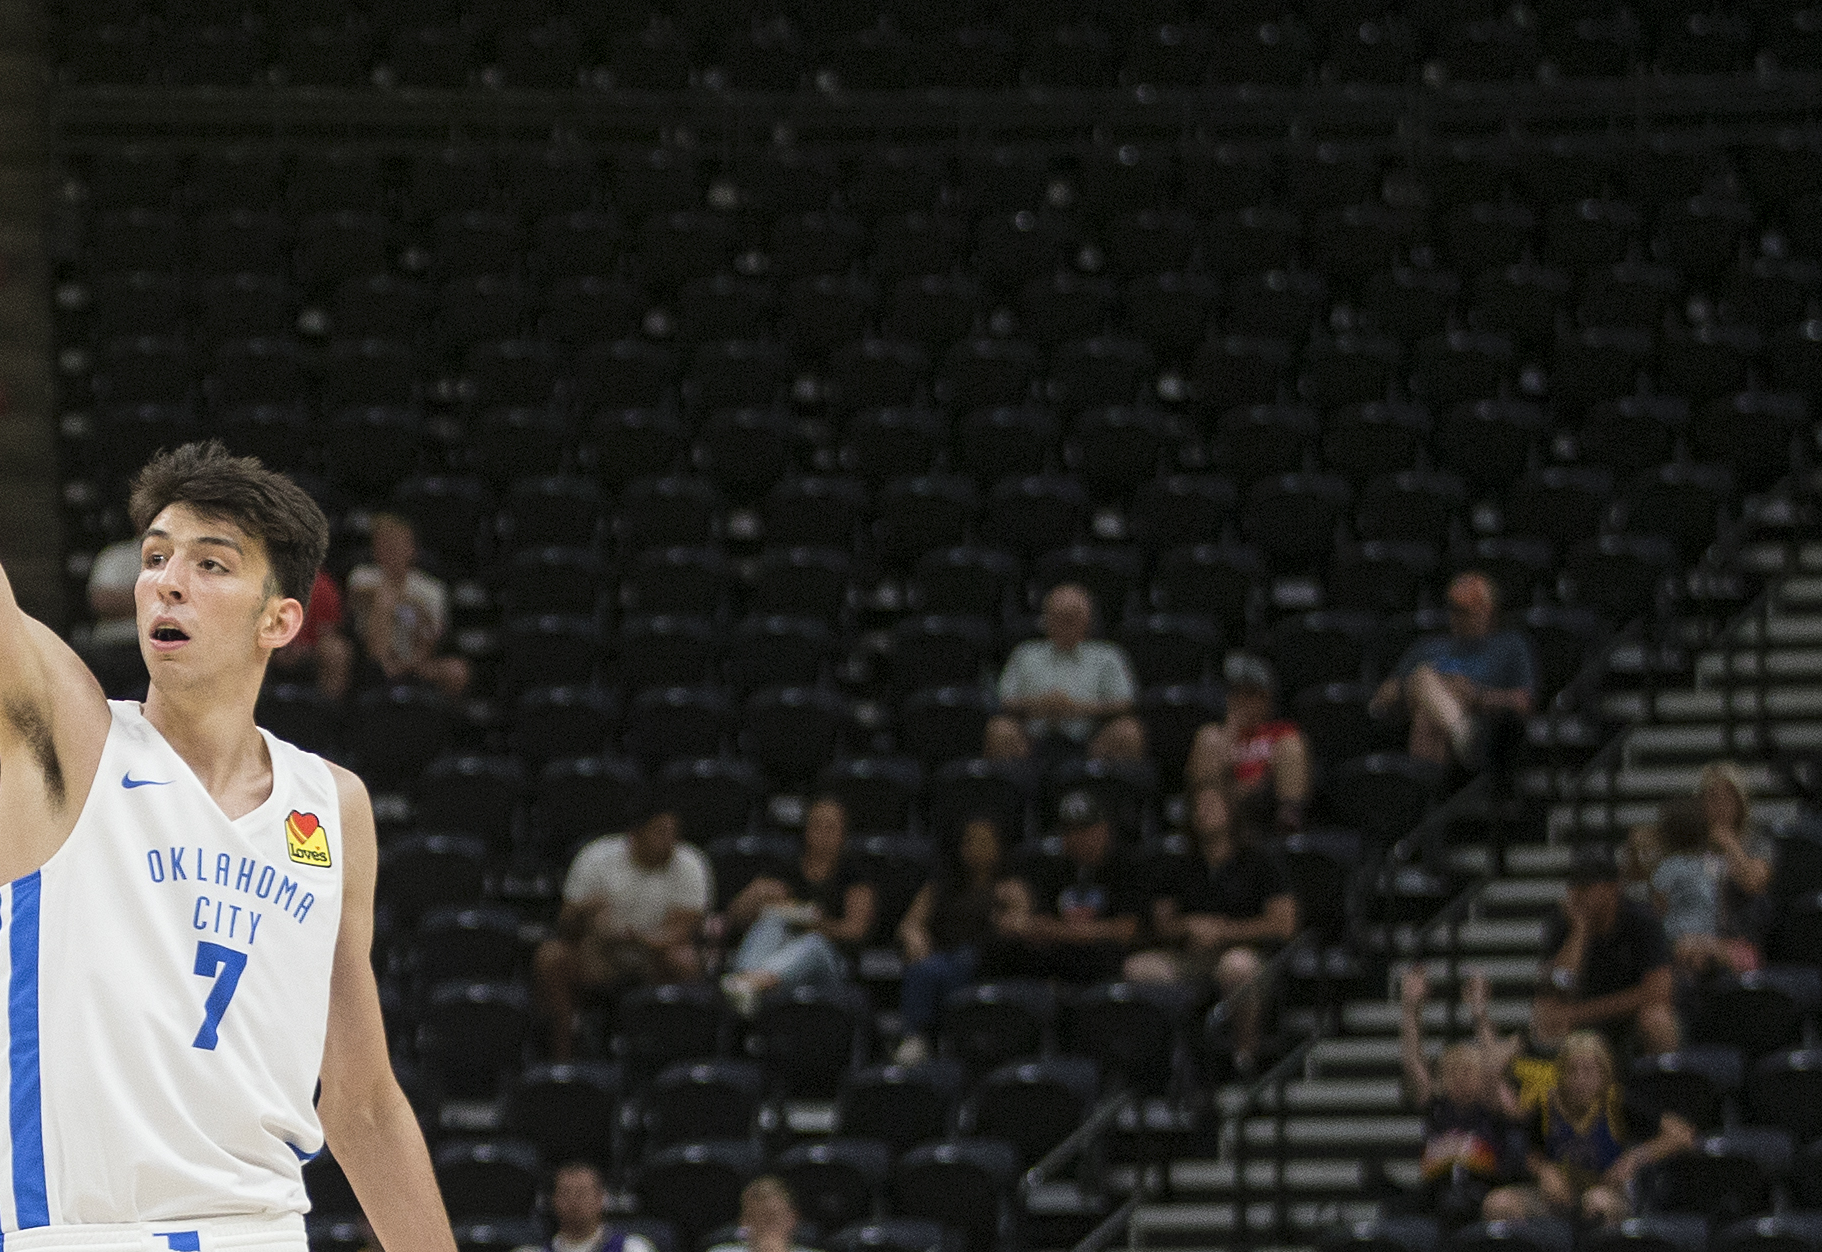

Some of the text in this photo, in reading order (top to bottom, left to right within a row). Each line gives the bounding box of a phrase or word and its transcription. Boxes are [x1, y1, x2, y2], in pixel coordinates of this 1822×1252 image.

[146, 846, 316, 925] OKLAHOMA
[192, 895, 262, 946] CITY
[191, 939, 249, 1052] 7
